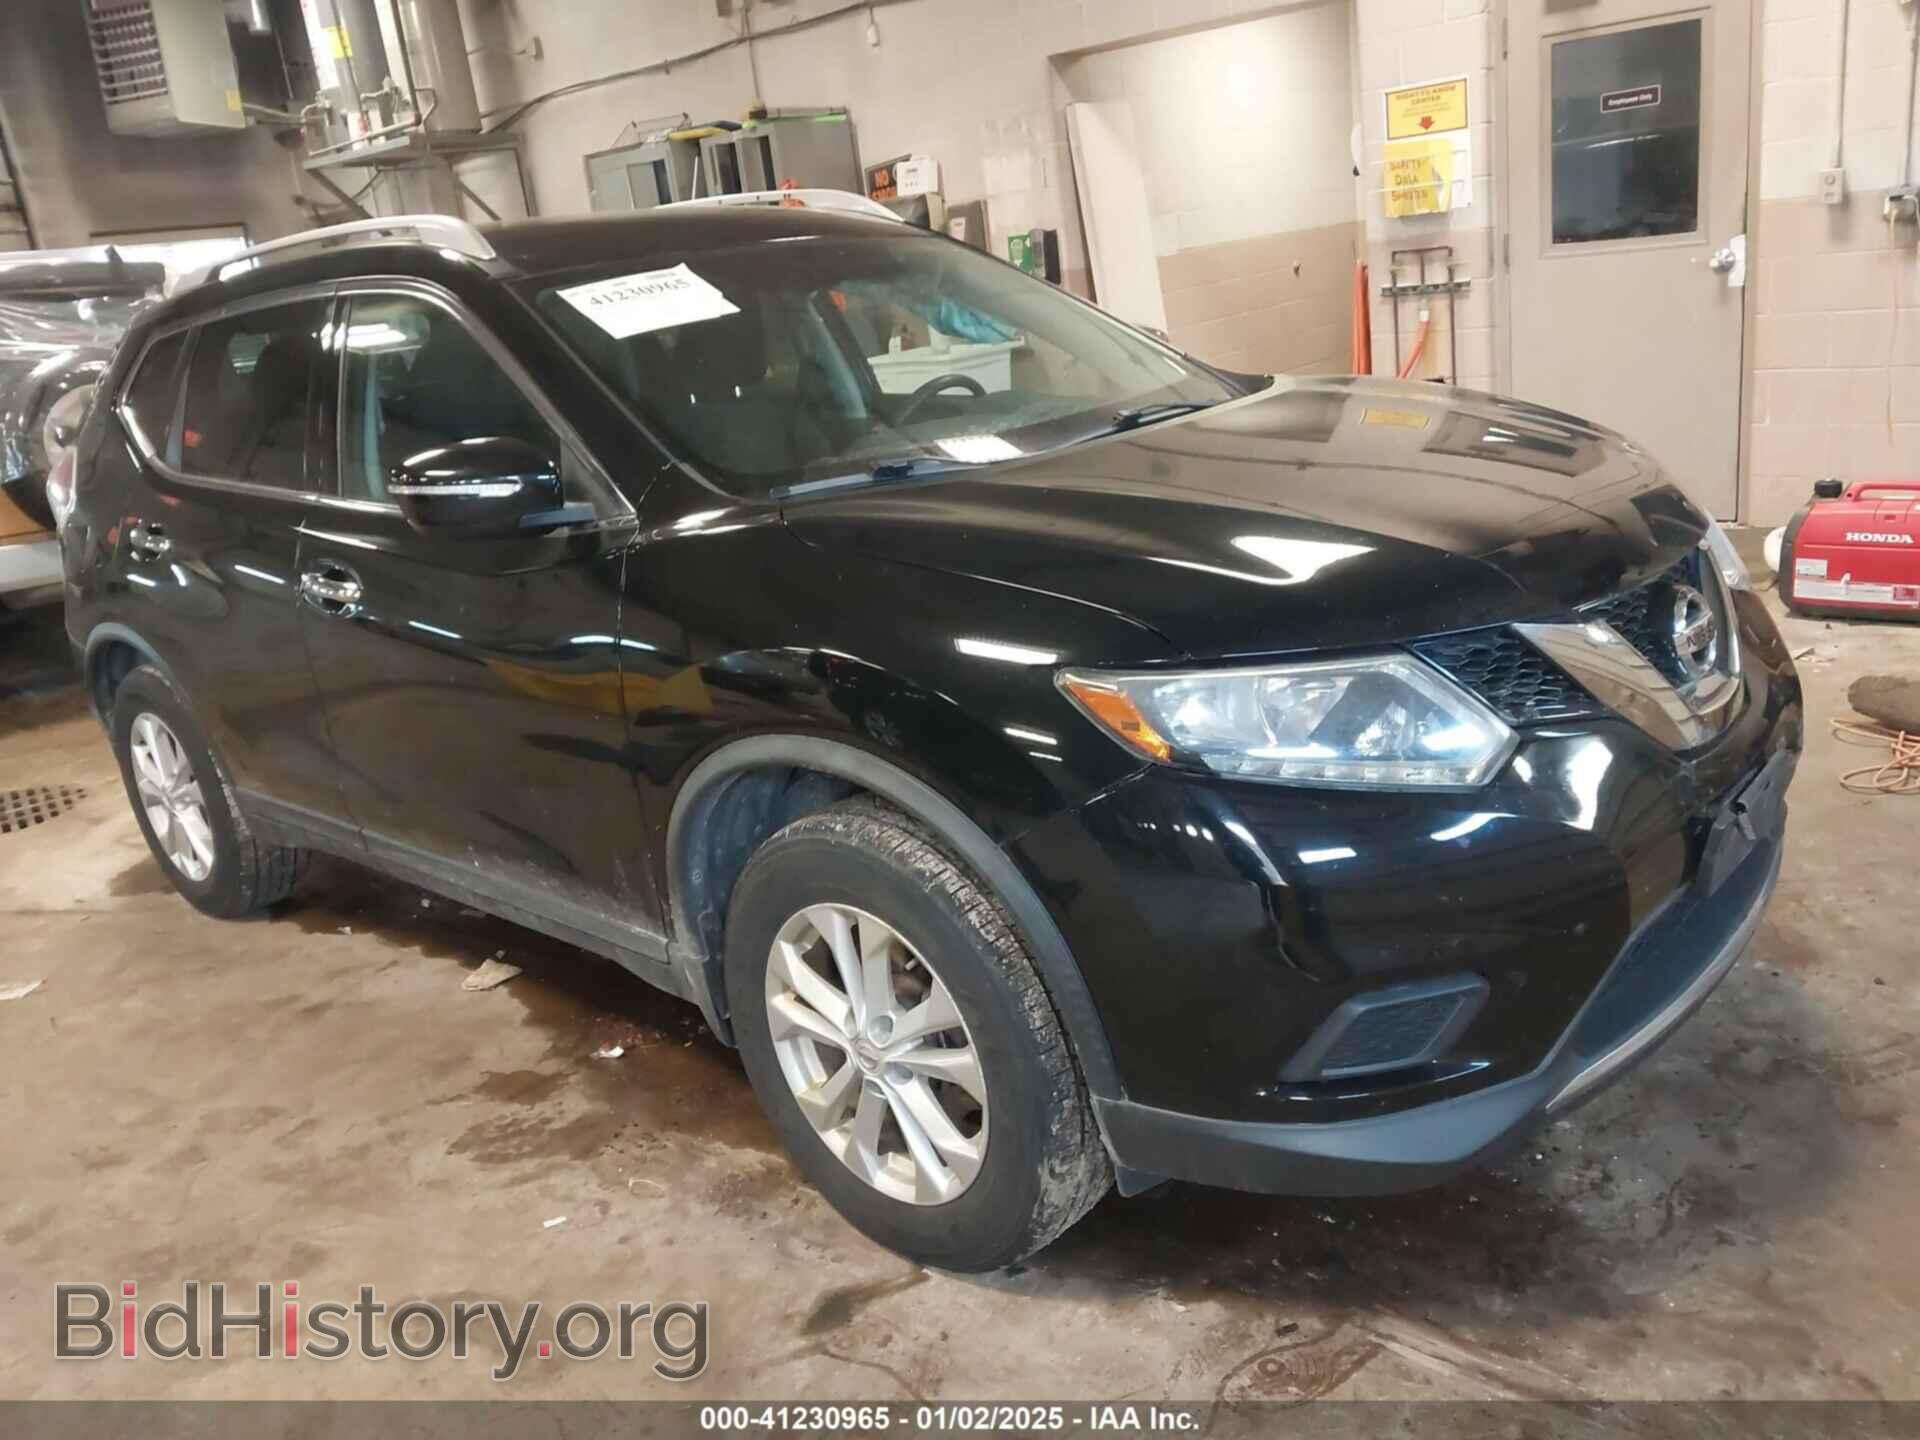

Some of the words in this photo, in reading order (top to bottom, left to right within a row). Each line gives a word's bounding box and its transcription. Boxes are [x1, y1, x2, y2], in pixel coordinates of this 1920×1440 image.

[875, 168, 889, 188] NO
[589, 278, 691, 306] 41230965
[1845, 531, 1914, 544] HONDA
